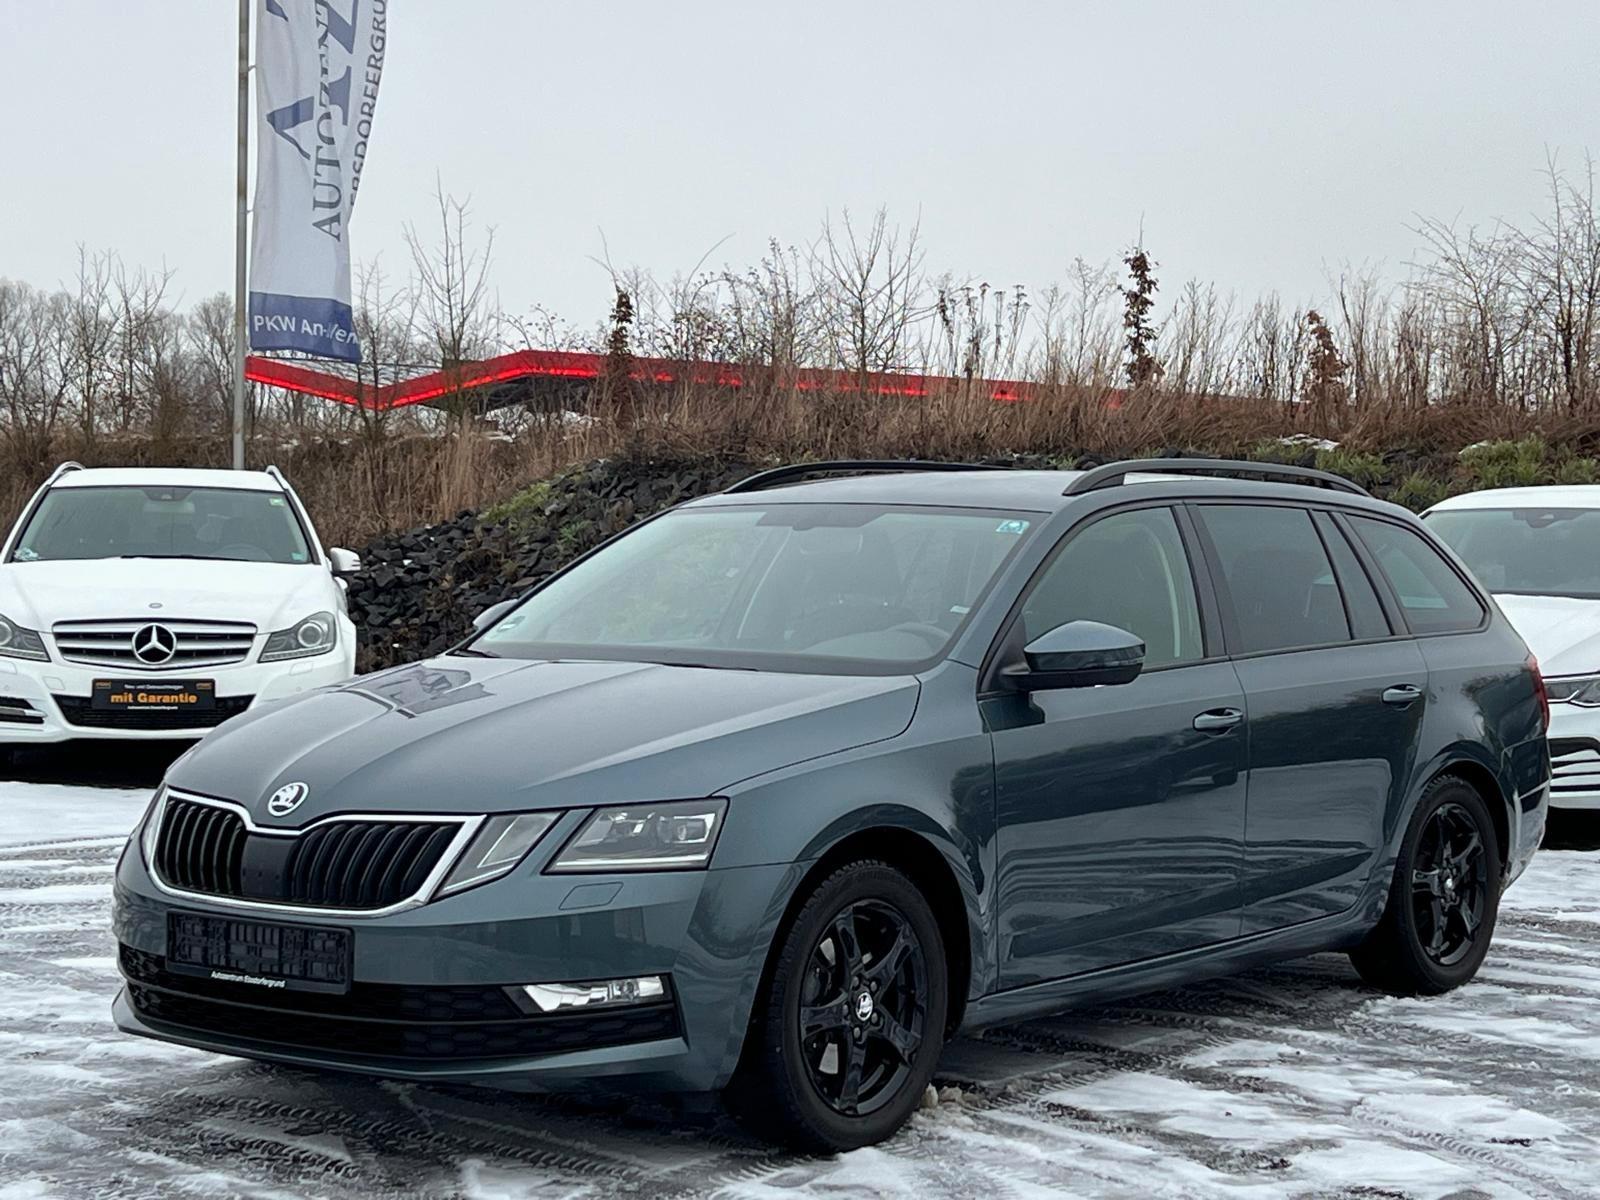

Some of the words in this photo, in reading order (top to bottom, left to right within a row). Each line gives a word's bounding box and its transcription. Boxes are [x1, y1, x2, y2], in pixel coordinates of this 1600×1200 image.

[312, 0, 342, 242] AUTO
[253, 315, 296, 332] PKW
[110, 692, 134, 703] mit
[137, 692, 198, 703] Garantie
